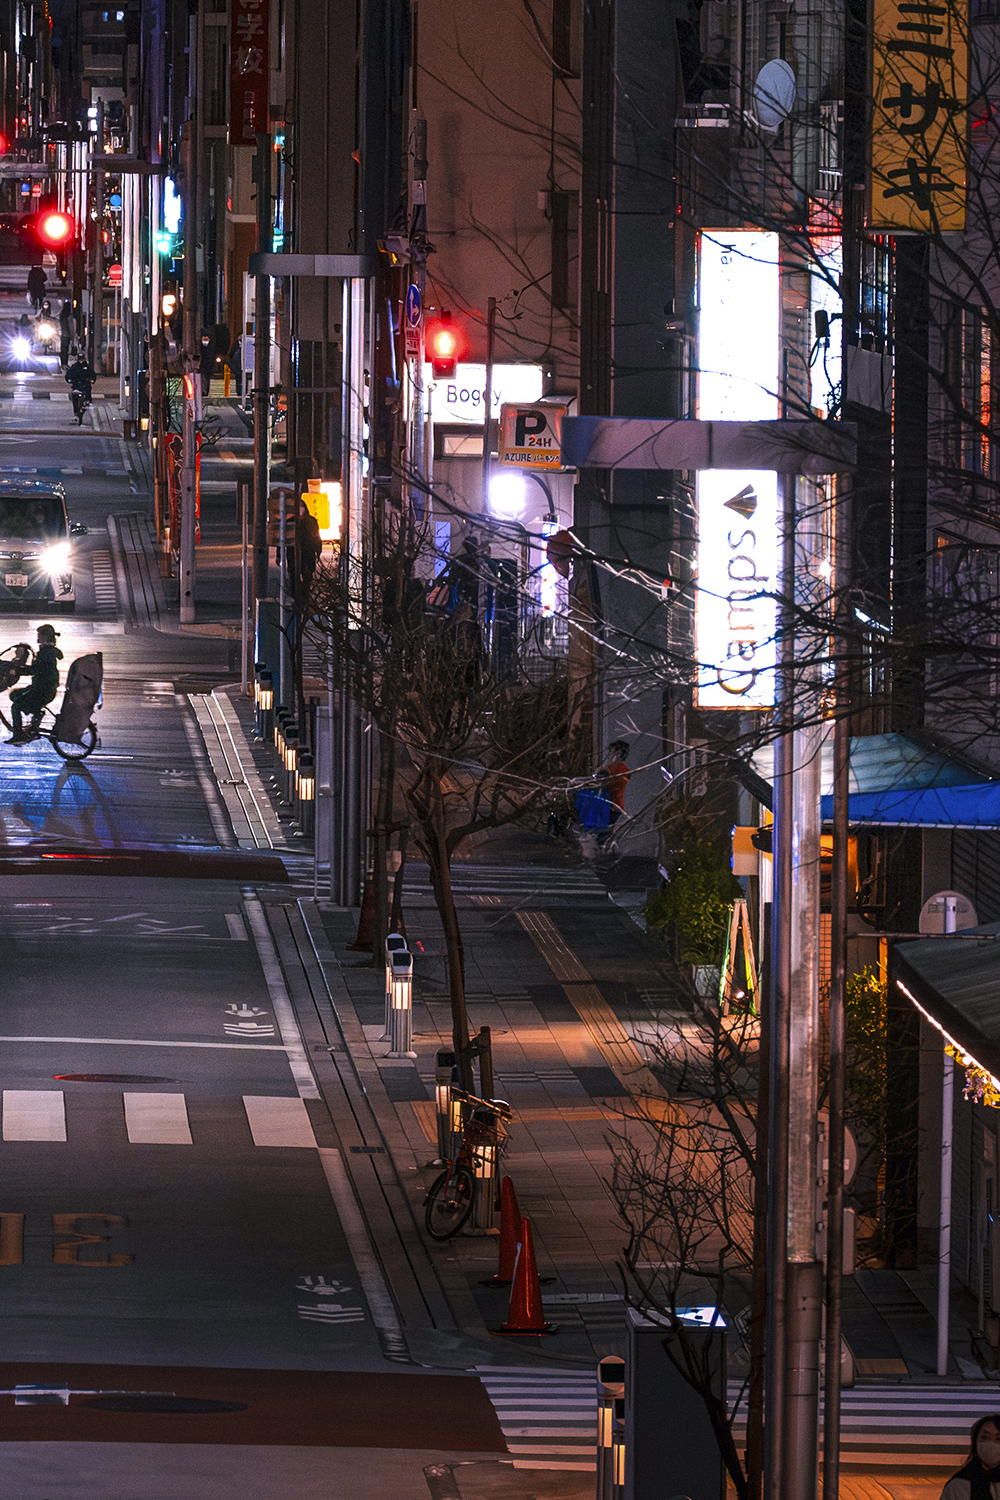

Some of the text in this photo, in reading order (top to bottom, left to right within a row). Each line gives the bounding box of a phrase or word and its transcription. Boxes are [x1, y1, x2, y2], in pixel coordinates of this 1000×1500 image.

[515, 409, 547, 447] P
[528, 437, 552, 448] 24H
[504, 452, 532, 463] AZURE
[718, 530, 770, 693] Camps
